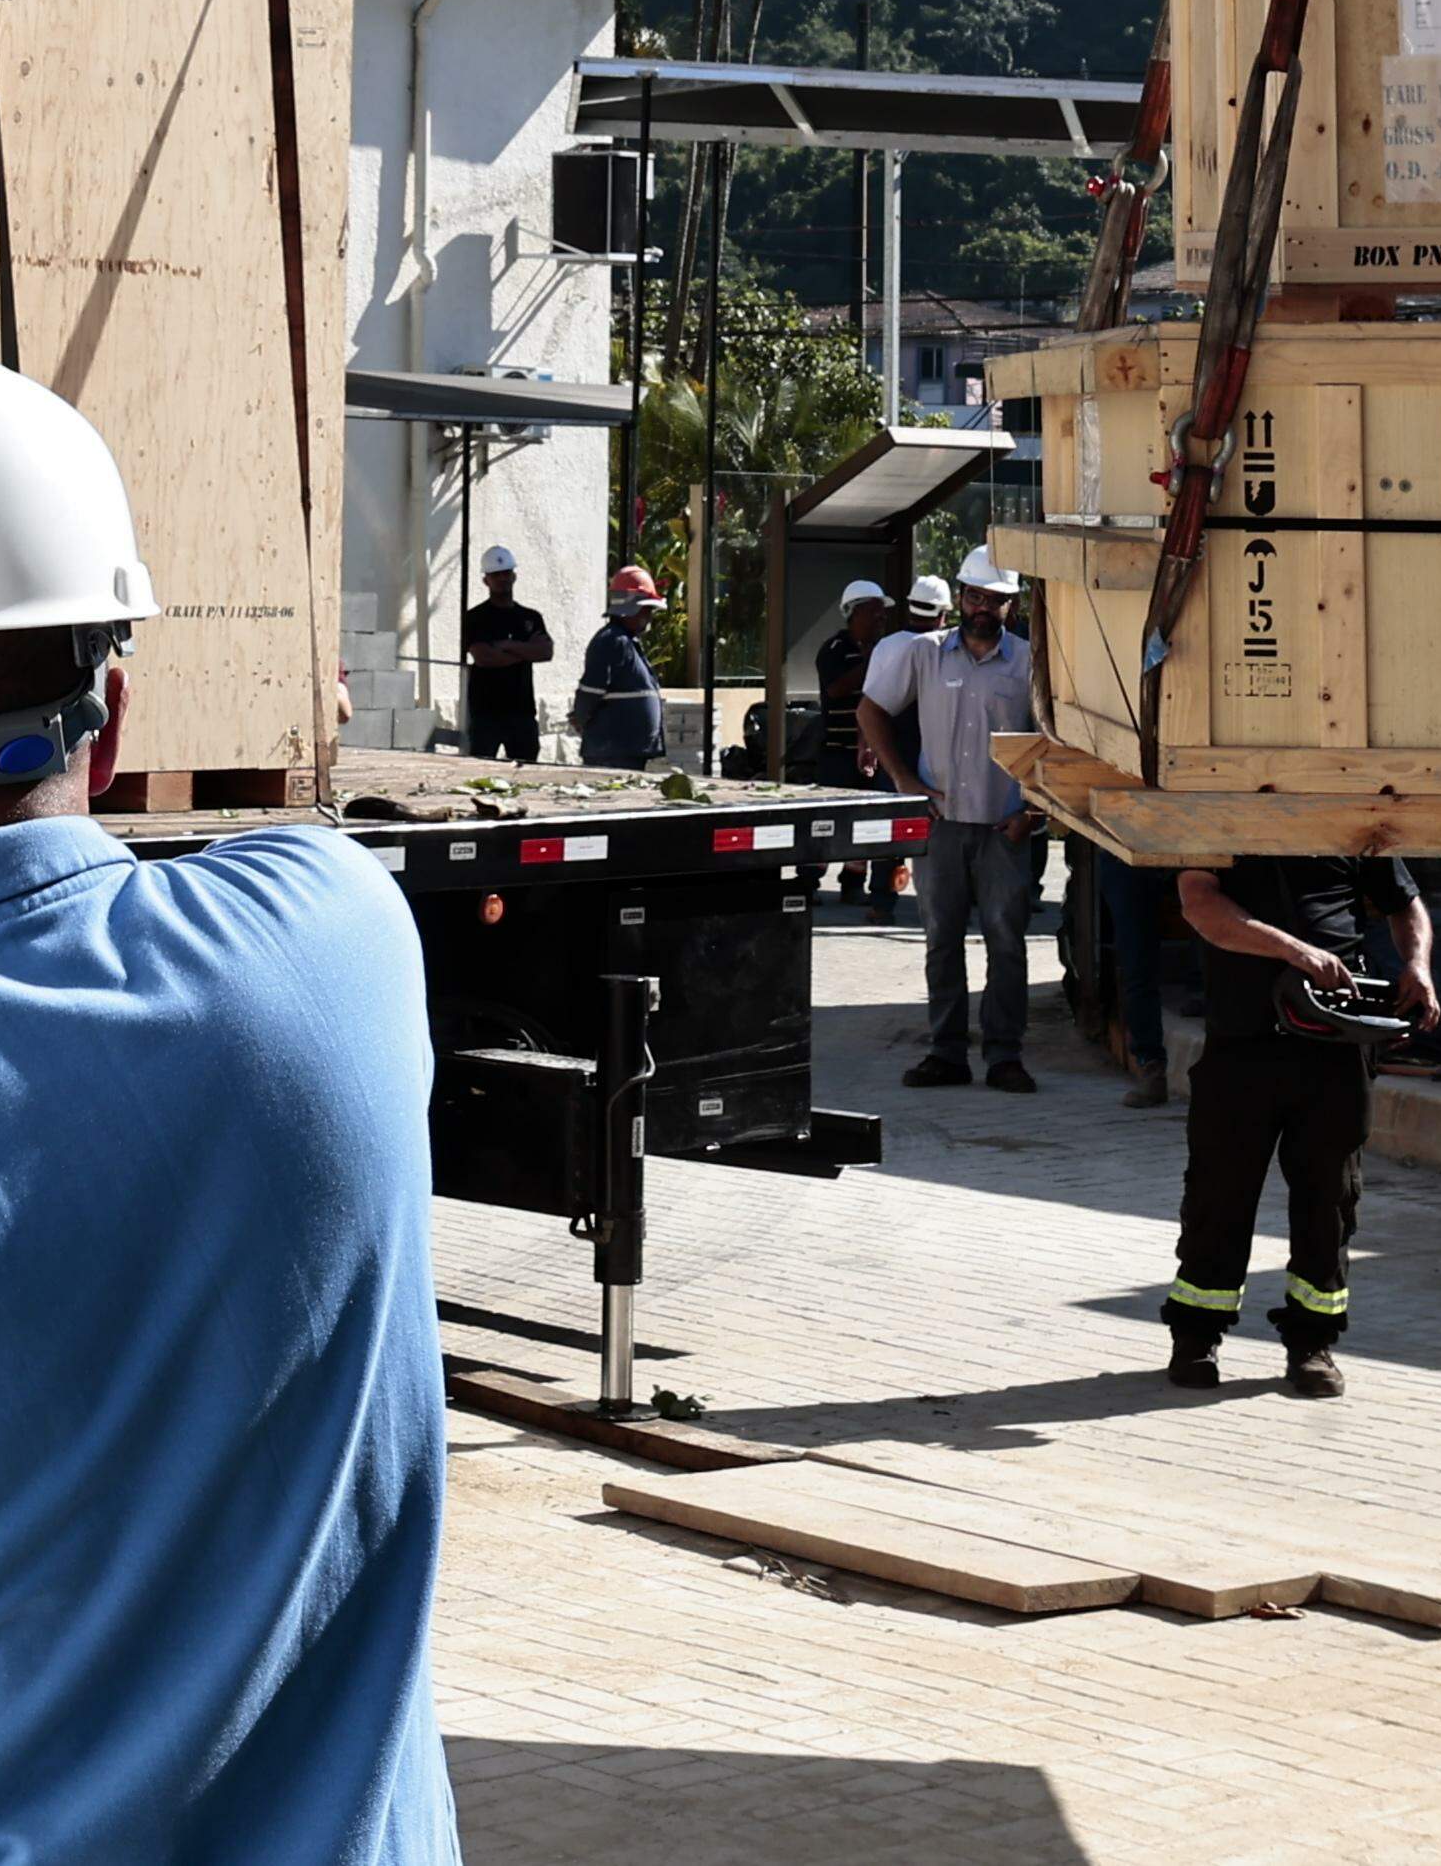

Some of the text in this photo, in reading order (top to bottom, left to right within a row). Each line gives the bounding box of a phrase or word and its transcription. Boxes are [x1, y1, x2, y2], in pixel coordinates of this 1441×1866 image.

[1383, 83, 1428, 105] TARE
[1383, 125, 1436, 147] GROSS
[1385, 161, 1428, 181] O.D.
[1353, 244, 1401, 267] BOX
[165, 604, 204, 618] CRATE
[206, 604, 226, 620] P/N
[1238, 599, 1274, 633] 5
